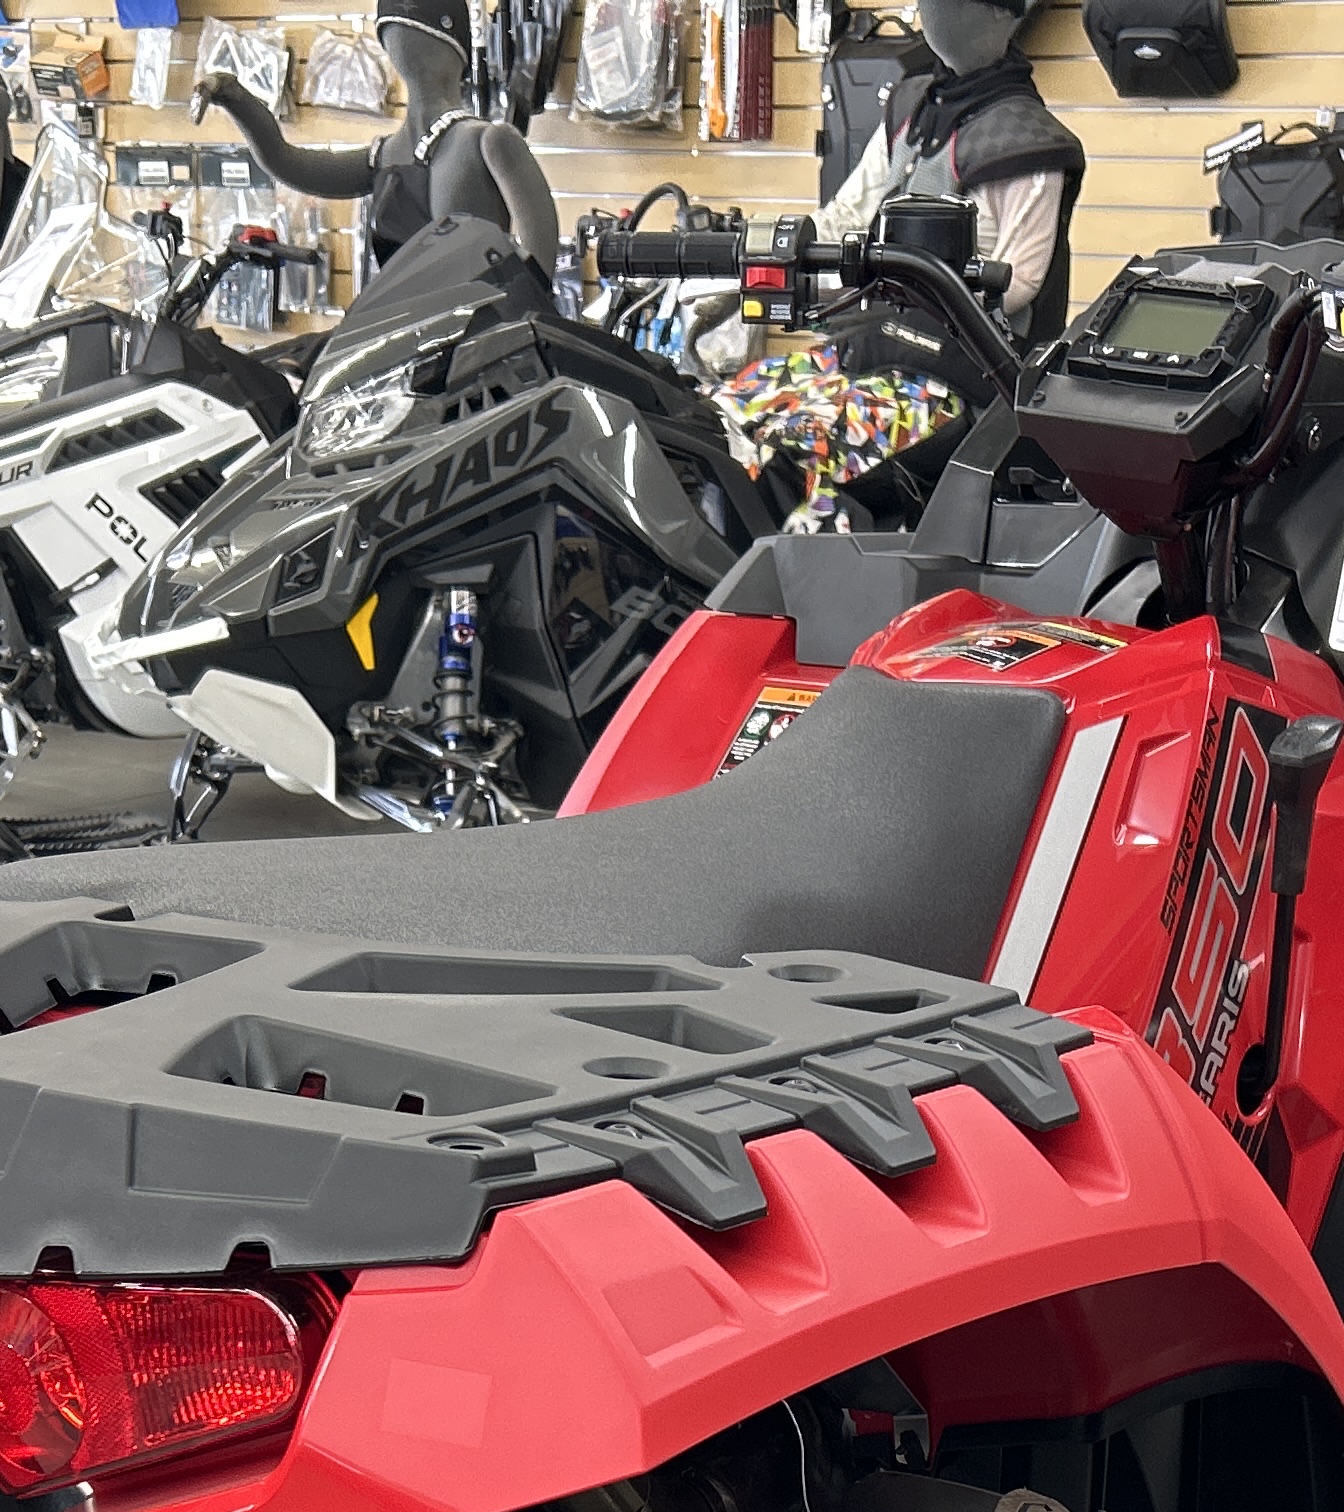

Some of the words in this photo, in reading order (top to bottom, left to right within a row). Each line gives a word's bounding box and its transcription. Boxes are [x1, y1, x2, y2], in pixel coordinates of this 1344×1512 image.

[359, 400, 572, 540] KHAOS
[1160, 702, 1220, 937] SPORTSMAN
[1199, 959, 1250, 1107] ARIS
